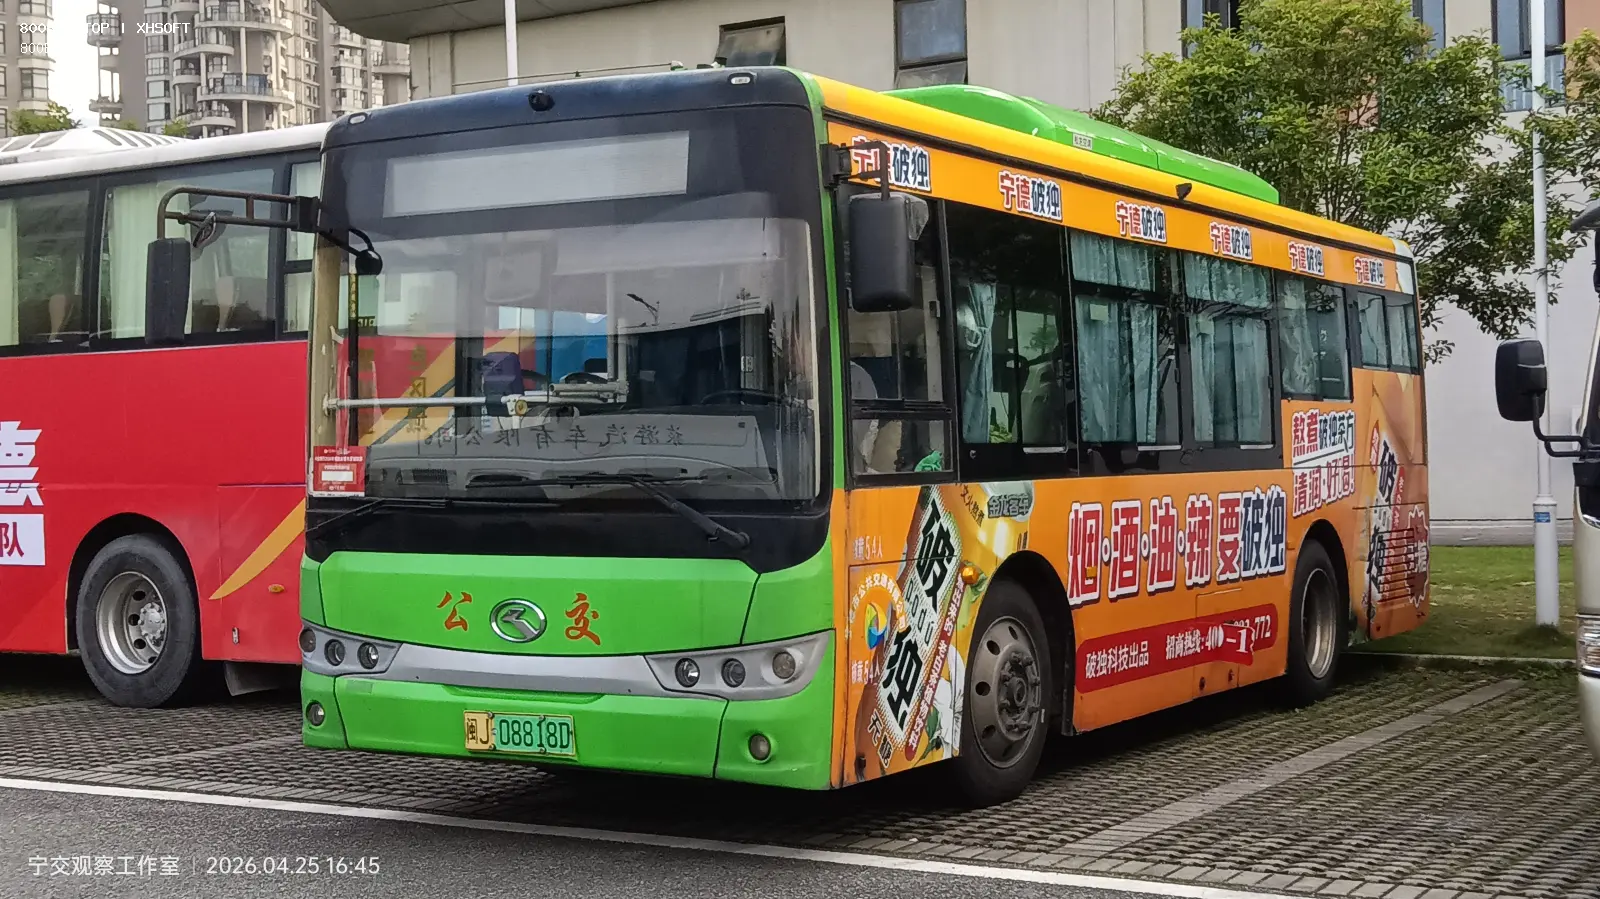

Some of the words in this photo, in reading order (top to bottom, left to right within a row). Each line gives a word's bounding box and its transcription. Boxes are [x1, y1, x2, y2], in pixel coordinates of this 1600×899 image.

[999, 171, 1062, 221] 宁德破独
[1116, 200, 1167, 243] 宁德破独
[1210, 221, 1252, 260] 宁德破独
[1288, 241, 1325, 276] 宁德破独
[436, 590, 473, 632] 公
[565, 592, 601, 646] 交
[1085, 640, 1150, 680] 破独科技出品
[499, 718, 571, 749] 08818D
